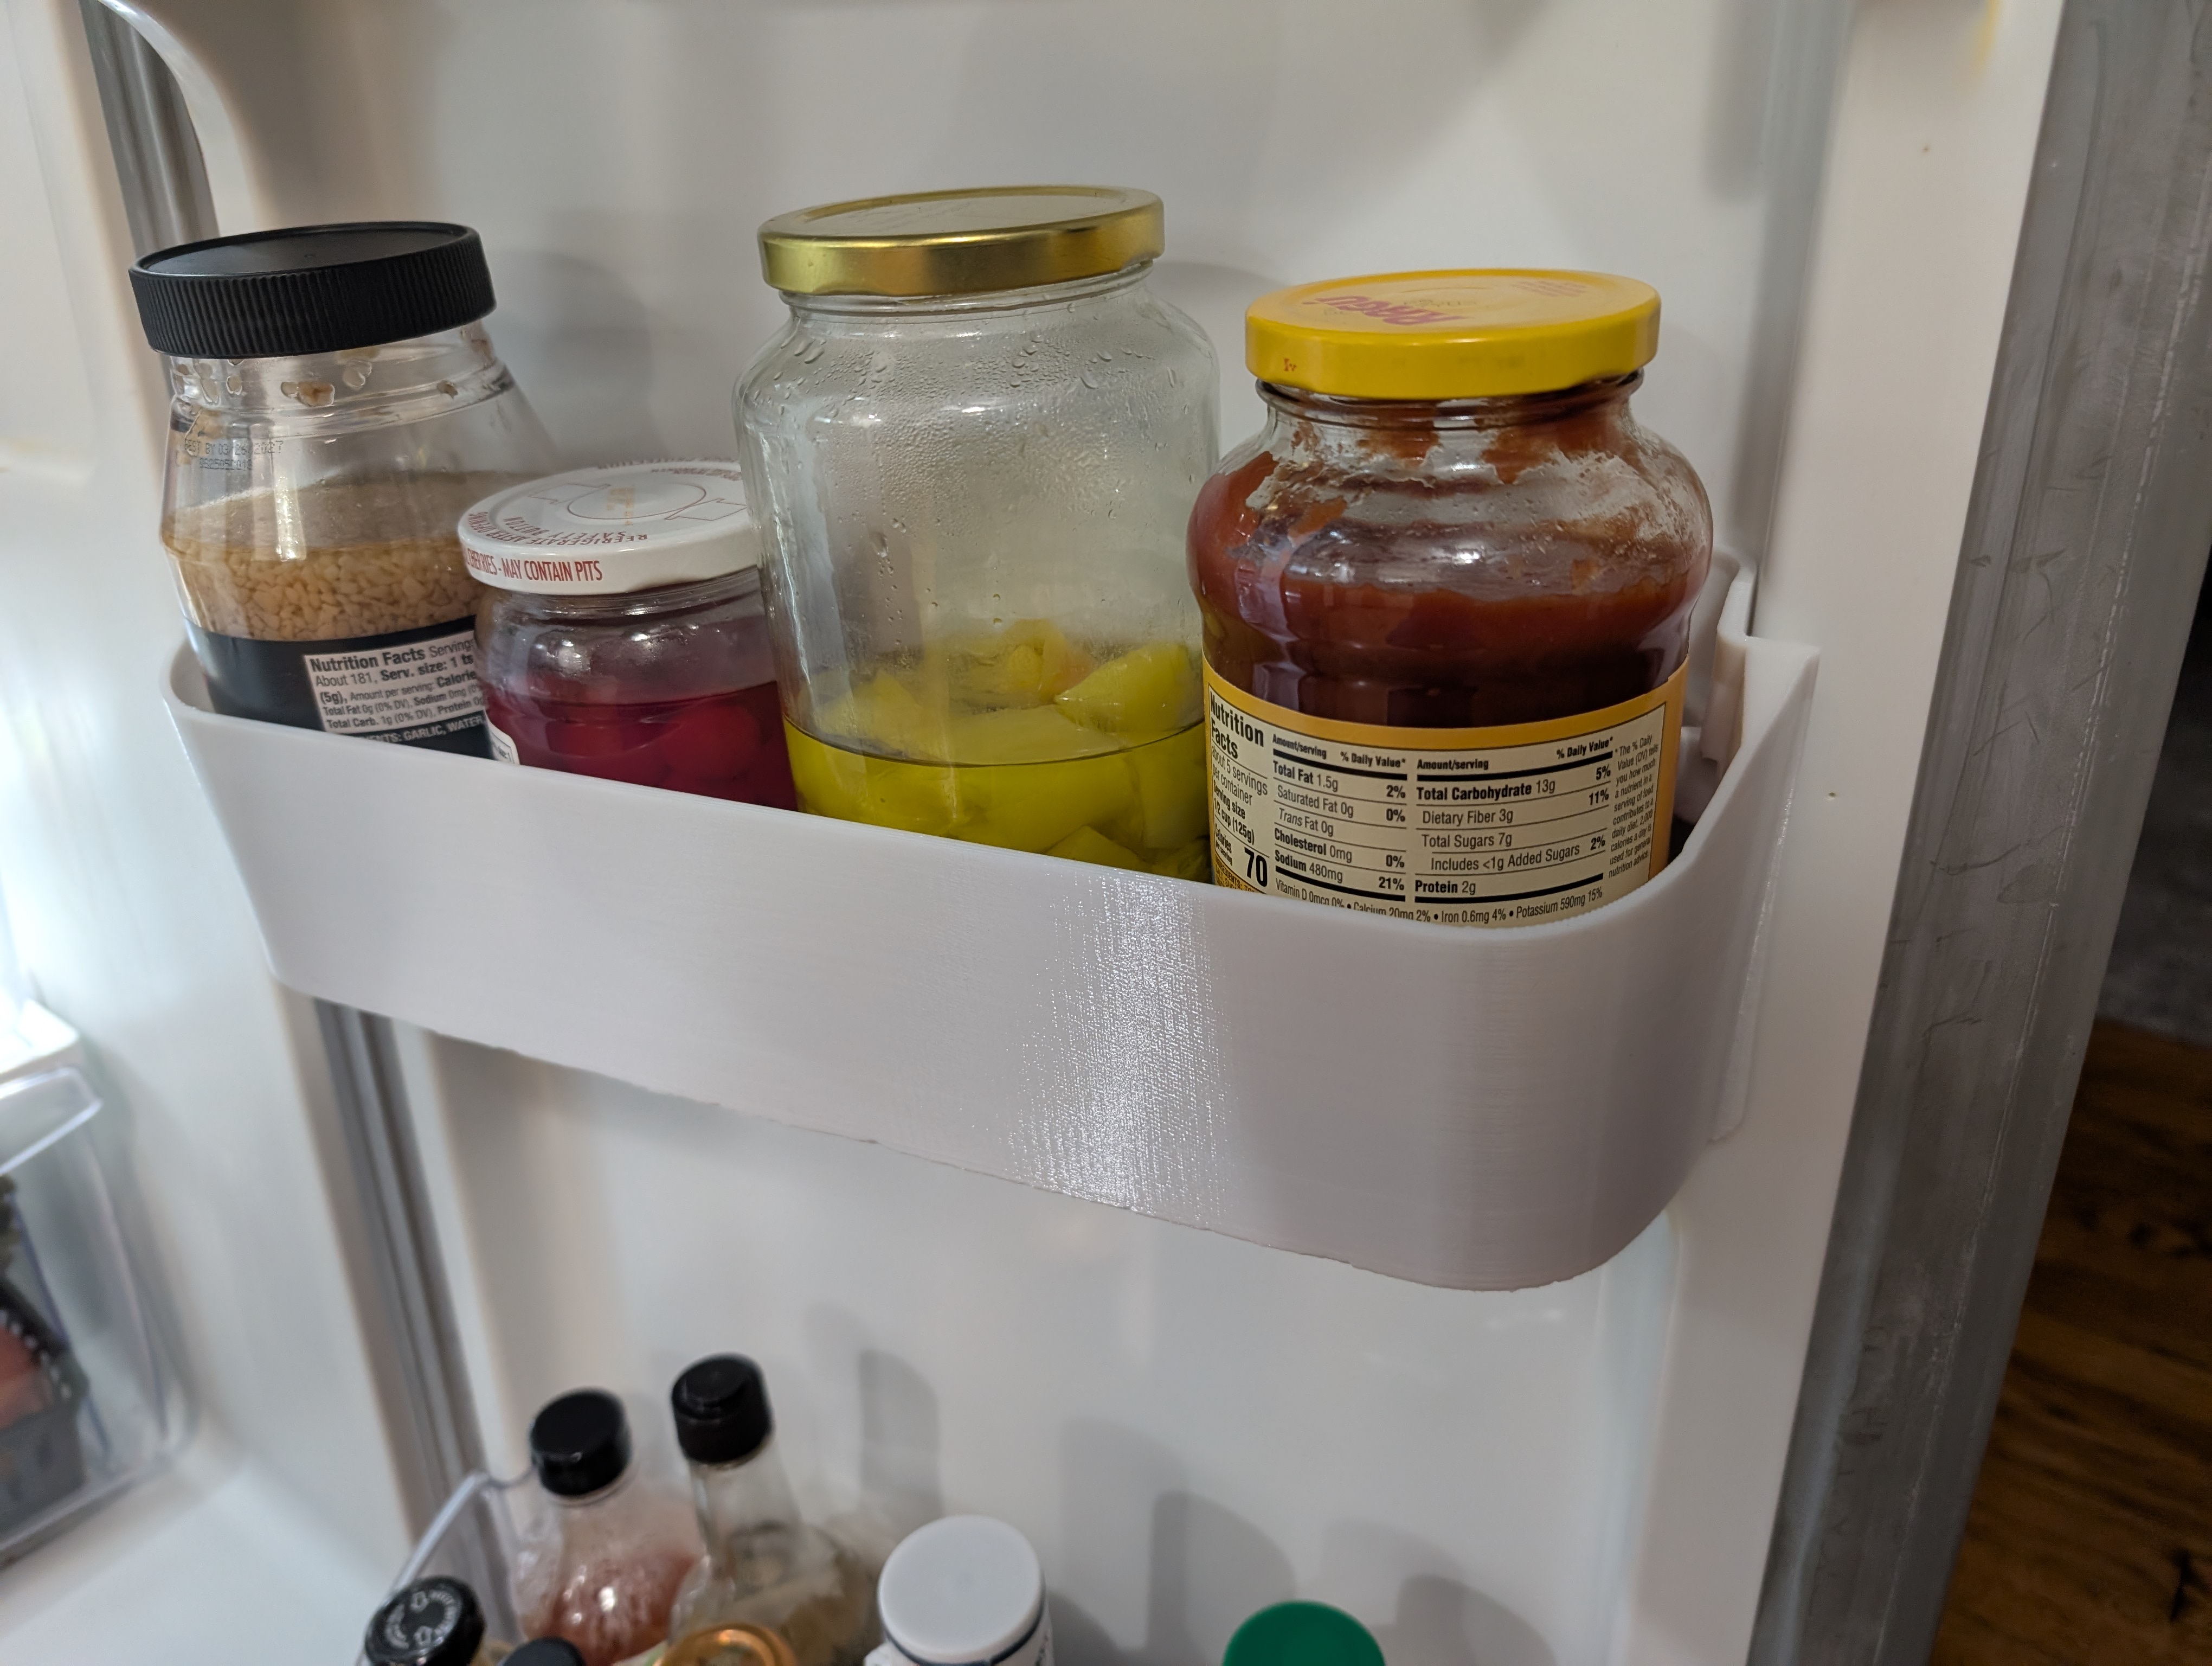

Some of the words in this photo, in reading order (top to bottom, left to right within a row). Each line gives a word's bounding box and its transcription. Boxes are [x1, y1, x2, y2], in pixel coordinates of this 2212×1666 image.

[205, 443, 215, 454] BY
[468, 512, 497, 533] OPENING
[486, 530, 531, 542] AFTER
[503, 517, 549, 536] BUTTON
[547, 531, 627, 540] SAFETY
[525, 534, 648, 546] REFRIGERATE
[501, 558, 523, 579] MAY
[524, 560, 573, 581] CONTAIN
[574, 560, 603, 581] PITS
[310, 656, 379, 672] Nutrition
[382, 648, 426, 666] Facts
[316, 674, 349, 687] About
[351, 672, 378, 684] 181,
[381, 668, 414, 681] Serv.
[418, 661, 447, 675] size:
[450, 657, 458, 668] 1
[461, 653, 474, 665] ts
[320, 690, 348, 705] (5g),
[350, 689, 383, 701] Amount
[385, 688, 398, 699] per
[437, 670, 476, 688] Calorie
[323, 706, 345, 715] Total
[346, 706, 361, 714] Fat
[362, 704, 374, 714] 0g
[376, 702, 393, 713] (0%
[414, 694, 447, 705] Sodium
[448, 689, 466, 699] 0mg
[326, 719, 351, 728] Total
[353, 716, 379, 727] Carb.
[381, 715, 393, 726] 1g
[395, 712, 413, 724] (0%
[438, 700, 471, 714] Protein
[1210, 691, 1264, 747] Nutrition
[403, 725, 446, 741] GARLIC,
[1211, 716, 1238, 759] Facts
[1639, 734, 1652, 748] Daily
[1272, 734, 1327, 759] Amount/serving
[1340, 751, 1348, 761] %
[1351, 753, 1373, 767] Daily
[1417, 759, 1489, 770] Amount/serving
[1556, 748, 1565, 759] %
[1567, 744, 1586, 758] Daily
[1618, 757, 1634, 771] Value
[1635, 749, 1648, 765] (DV)
[1649, 744, 1658, 756] tells
[1212, 746, 1225, 770] about
[1226, 758, 1231, 774] 5
[1232, 766, 1268, 796] servings
[1273, 760, 1295, 779] Total
[1297, 768, 1314, 785] Fat
[1316, 774, 1338, 792] 1.5g
[1386, 785, 1406, 799] 2%
[1417, 786, 1448, 800] Total
[1451, 783, 1532, 801] Carbohydrate
[1536, 779, 1555, 794] 13g
[1596, 764, 1611, 781] 5%
[1616, 773, 1627, 787] you
[1629, 767, 1641, 779] how
[1642, 758, 1656, 773] much
[1213, 779, 1231, 811] Serving
[1232, 801, 1245, 819] size
[1221, 773, 1252, 805] container
[1614, 797, 1636, 812] serving
[1636, 790, 1642, 802] of
[1643, 783, 1654, 798] food
[1615, 790, 1619, 799] a
[1621, 778, 1642, 796] nutrient
[1643, 776, 1648, 785] in
[1649, 773, 1652, 781] a
[1277, 785, 1319, 809] Saturated
[1322, 798, 1338, 813] Fat
[1340, 802, 1354, 818] 0g
[1386, 808, 1405, 822] 0%
[1422, 809, 1464, 827] Dietary
[1467, 809, 1496, 824] Fiber
[1499, 808, 1514, 824] 3g
[1589, 789, 1610, 805] 11%
[1613, 804, 1644, 825] contributes
[1645, 799, 1650, 809] to
[1650, 798, 1654, 806] a
[1221, 810, 1231, 828] cup
[1232, 816, 1255, 845] (125g)
[1278, 808, 1302, 826] Trans
[1304, 816, 1319, 831] Fat
[1321, 821, 1334, 837] 0g
[1612, 825, 1625, 839] daily
[1639, 809, 1653, 825] 2,000
[1215, 822, 1232, 854] Calories
[1274, 828, 1326, 855] Cholesterol
[1329, 845, 1352, 863] 0mg
[1385, 854, 1405, 868] 0%
[1422, 834, 1450, 848] Total
[1454, 834, 1494, 850] Sugars
[1498, 832, 1513, 847] 7g
[1610, 835, 1633, 852] calories
[1634, 832, 1637, 841] a
[1638, 826, 1647, 839] day
[1648, 823, 1651, 832] is
[1610, 850, 1624, 865] used
[1625, 847, 1634, 858] for
[1634, 835, 1651, 855] general
[1220, 847, 1232, 866] serving
[1244, 847, 1268, 887] 70
[1431, 857, 1479, 870] Includes
[1482, 856, 1504, 871] <1g
[1507, 851, 1541, 868] Added
[1545, 844, 1580, 862] Sugars
[1590, 836, 1606, 851] 2%
[1275, 849, 1307, 872] Sodium
[1309, 862, 1343, 884] 480mg
[1378, 876, 1405, 891] 21%
[1609, 860, 1632, 879] nutrition
[1276, 877, 1300, 899] Vitamin
[1302, 888, 1307, 900] D
[1416, 909, 1431, 922] 2%
[1441, 910, 1459, 923] Iron
[1462, 910, 1489, 924] 0.6mg
[1491, 908, 1506, 921] 4%
[1516, 901, 1558, 919] Potassium
[1560, 894, 1586, 910] 590mg
[1588, 886, 1603, 902] 15%
[1414, 880, 1458, 893] Protein
[1462, 880, 1476, 895] 2g
